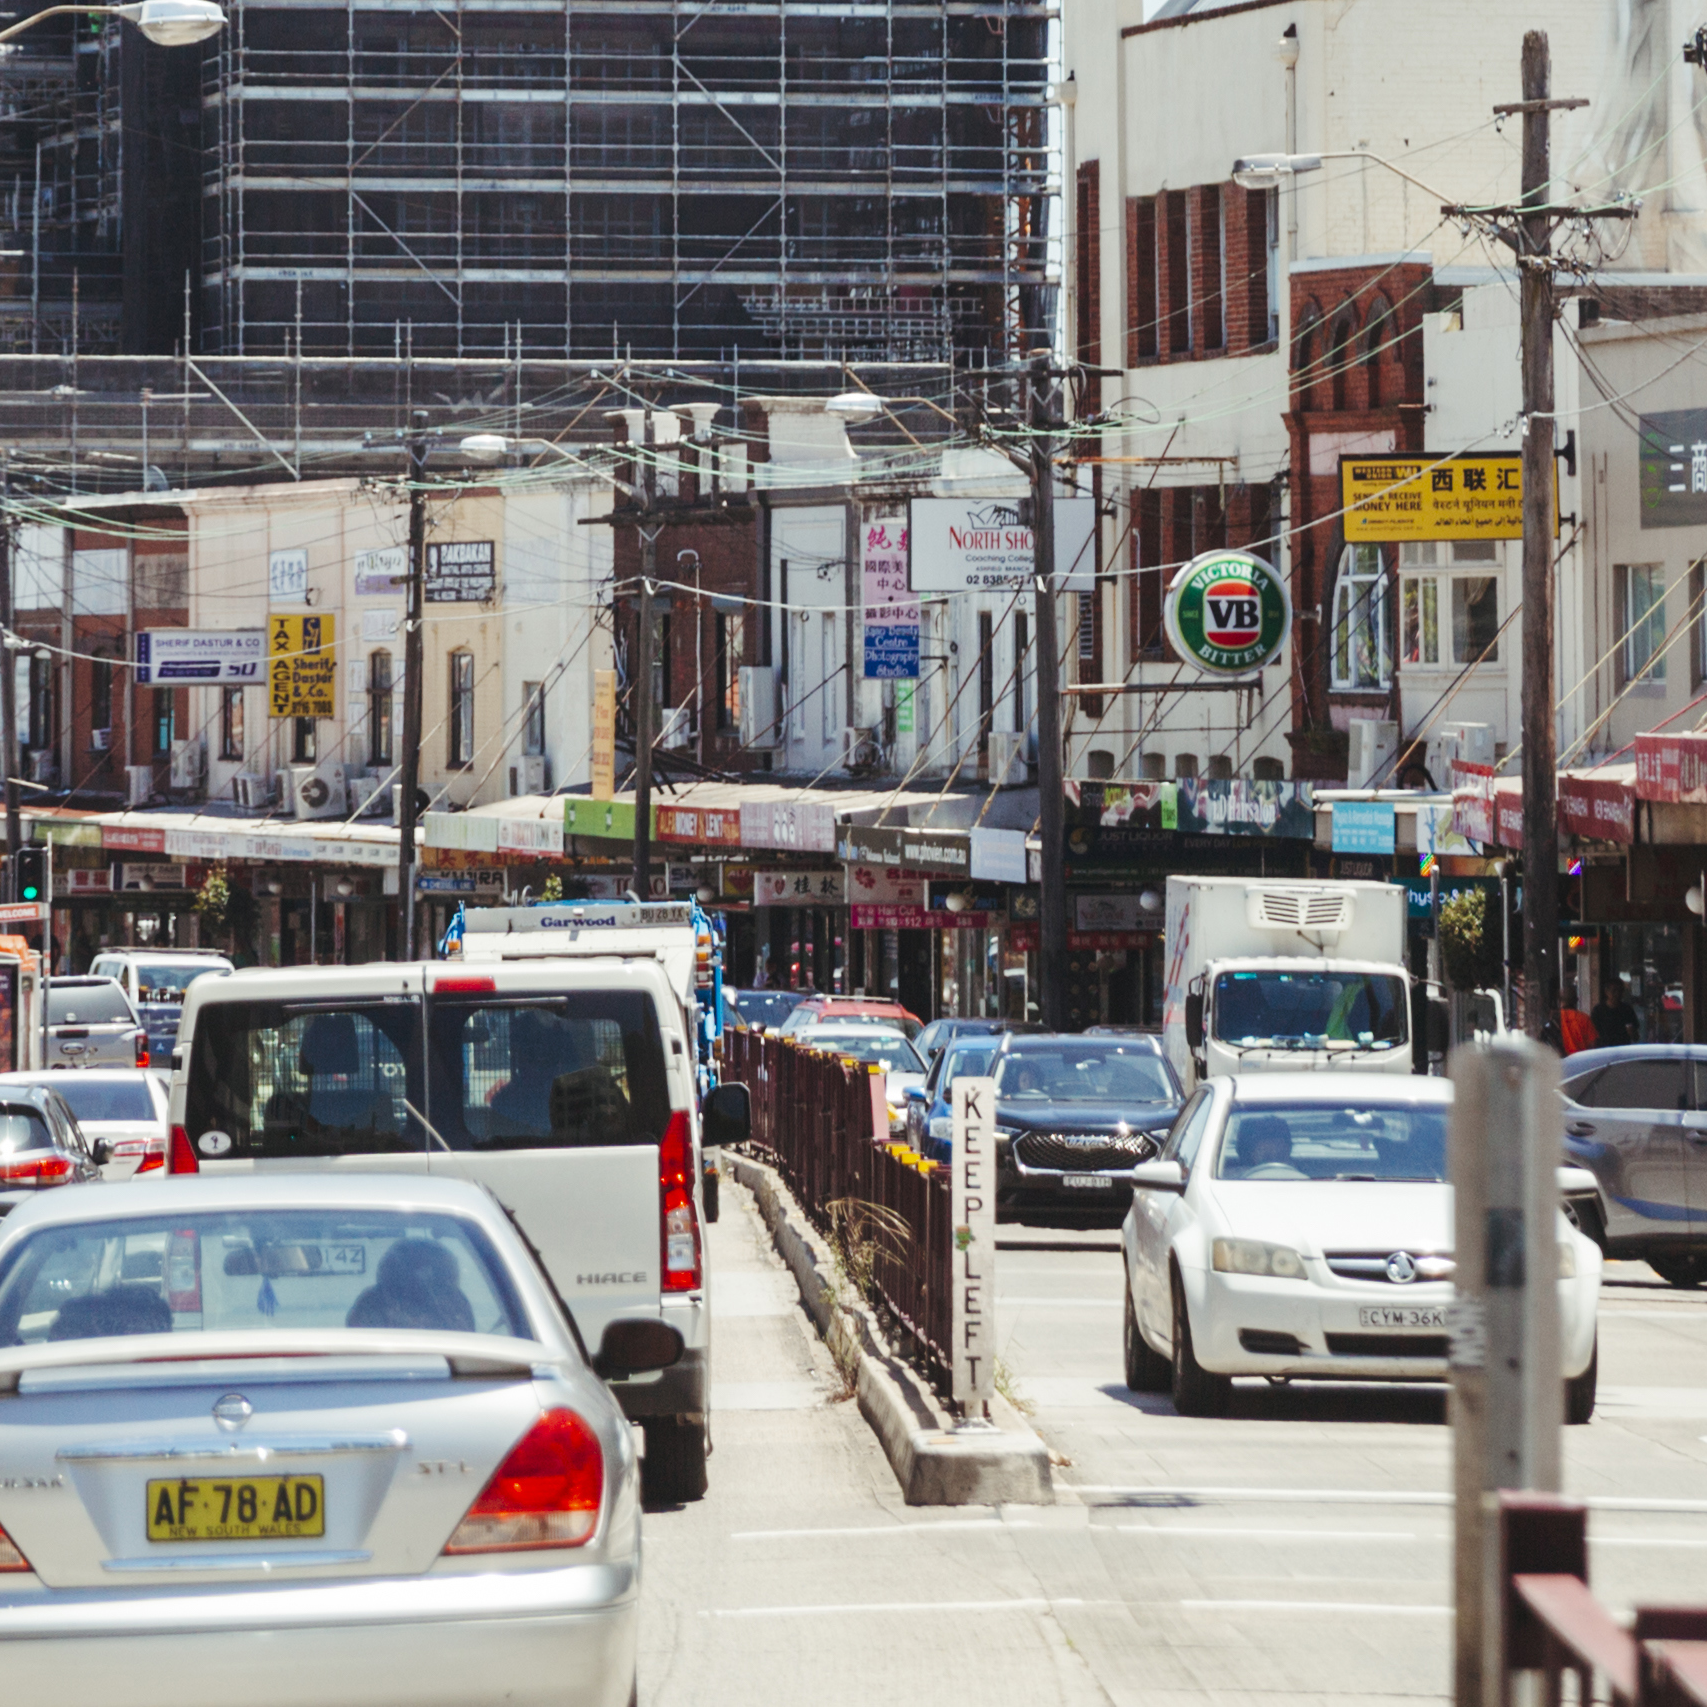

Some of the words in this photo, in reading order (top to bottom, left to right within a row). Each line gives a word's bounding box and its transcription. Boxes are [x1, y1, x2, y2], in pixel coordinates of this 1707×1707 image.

[1431, 467, 1520, 492] 西联汇
[1388, 492, 1422, 500] RECEIVE
[1396, 501, 1422, 511] HERE
[949, 525, 1000, 551] NORTH
[1005, 530, 1034, 551] SHO
[966, 554, 1006, 565] Coaching
[1008, 554, 1034, 565] Colleg
[864, 559, 905, 575] 國際美
[966, 575, 978, 585] 02
[1191, 561, 1268, 591] VICTORIA
[1207, 599, 1260, 629] VB
[273, 619, 290, 651] TAX
[875, 636, 908, 648] Centre
[156, 638, 190, 647] SHERIF
[193, 638, 235, 648] DASTUR
[236, 638, 243, 647] &
[245, 638, 260, 647] CO
[865, 649, 919, 665] Photography
[1199, 644, 1266, 665] BITTER
[294, 657, 329, 671] Sherif
[876, 663, 909, 677] Studio
[293, 671, 333, 683] Dastur
[273, 660, 291, 714] AGENT
[308, 685, 328, 698] Co.
[676, 811, 698, 835] MONEY
[705, 812, 724, 838] LENT
[1098, 831, 1127, 841] JUST
[1129, 831, 1173, 842] LIQUOR
[794, 876, 839, 895] 桂林
[899, 905, 916, 916] Cut
[541, 915, 616, 928] Garwood
[964, 1091, 984, 1224] KEEP
[576, 1272, 647, 1286] HIACE
[964, 1251, 982, 1389] LEFT
[169, 1526, 199, 1538] NEW
[205, 1525, 251, 1538] SOUTH
[258, 1523, 303, 1537] WALES
